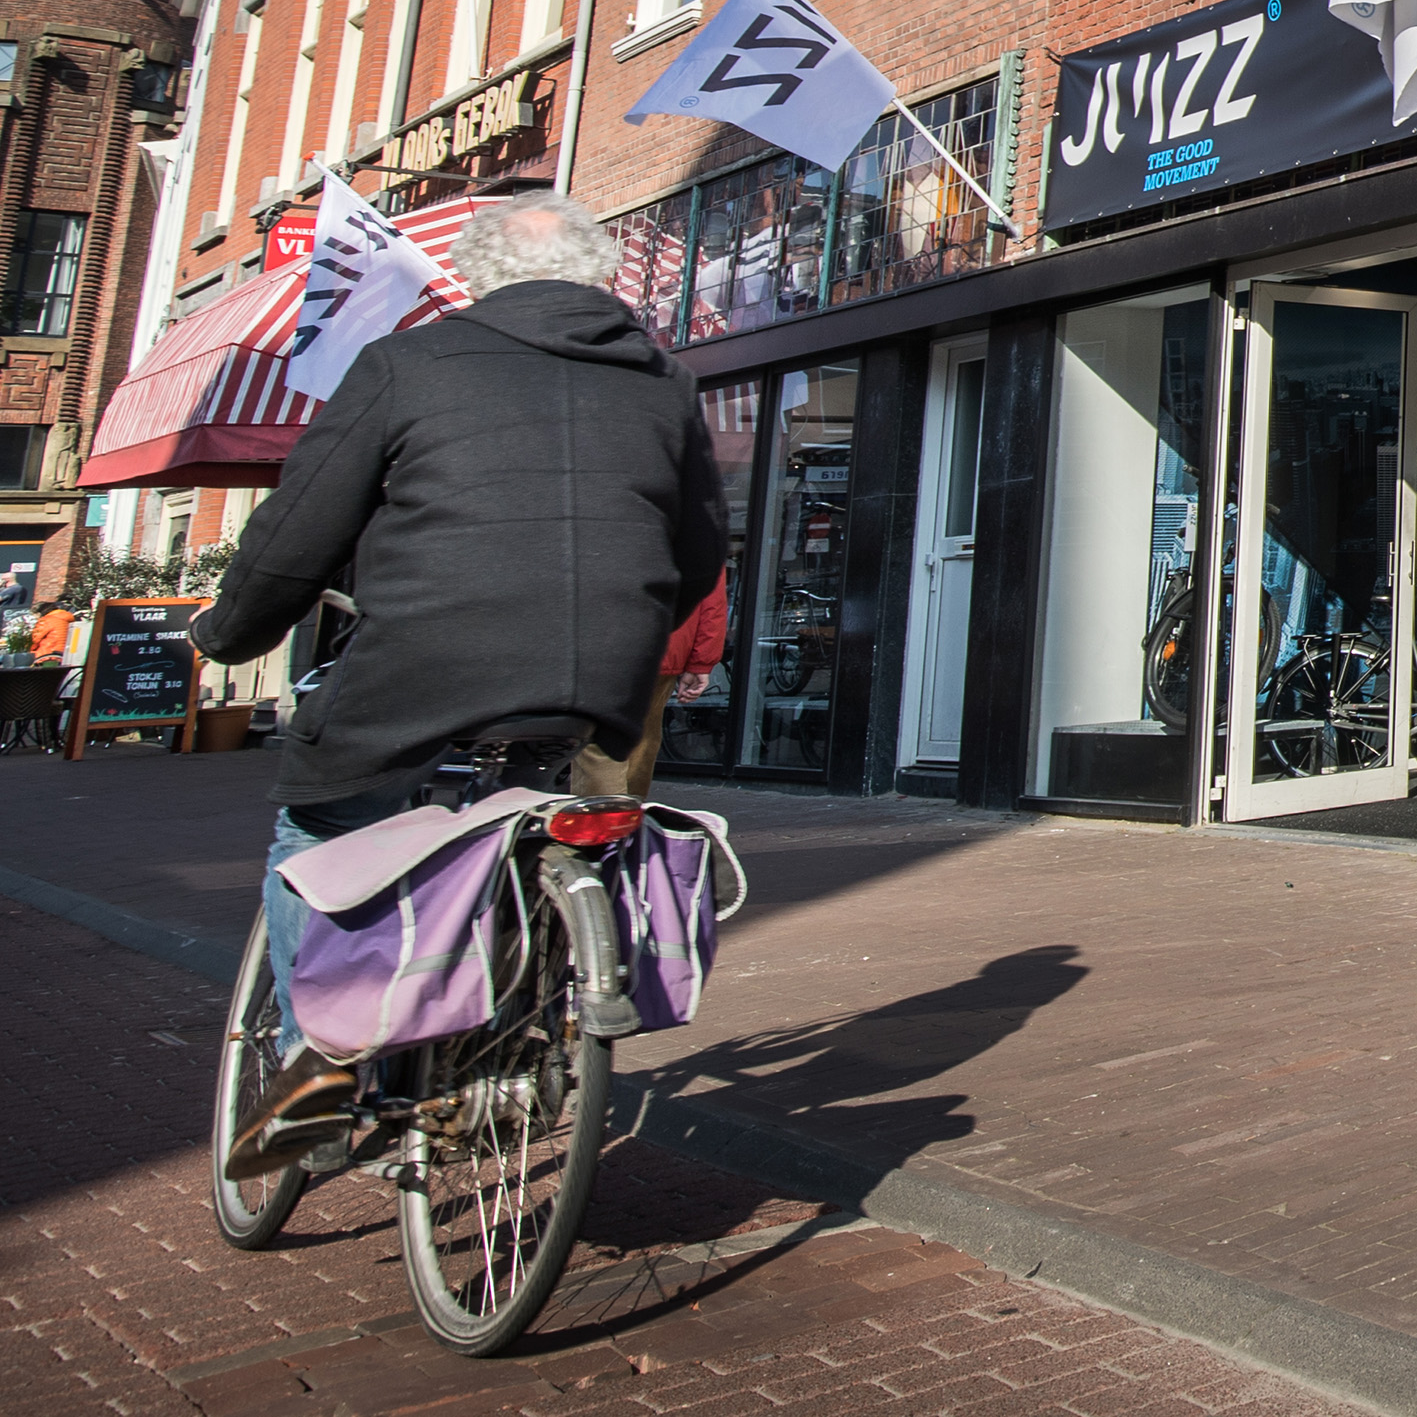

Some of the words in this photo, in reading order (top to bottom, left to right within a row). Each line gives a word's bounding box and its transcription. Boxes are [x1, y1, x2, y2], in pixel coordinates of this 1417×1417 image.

[452, 70, 530, 156] GEBAK
[1147, 148, 1174, 170] THE
[1175, 138, 1214, 163] GOOD
[1143, 156, 1221, 192] MOVEMENT
[106, 632, 151, 642] VITAMINE
